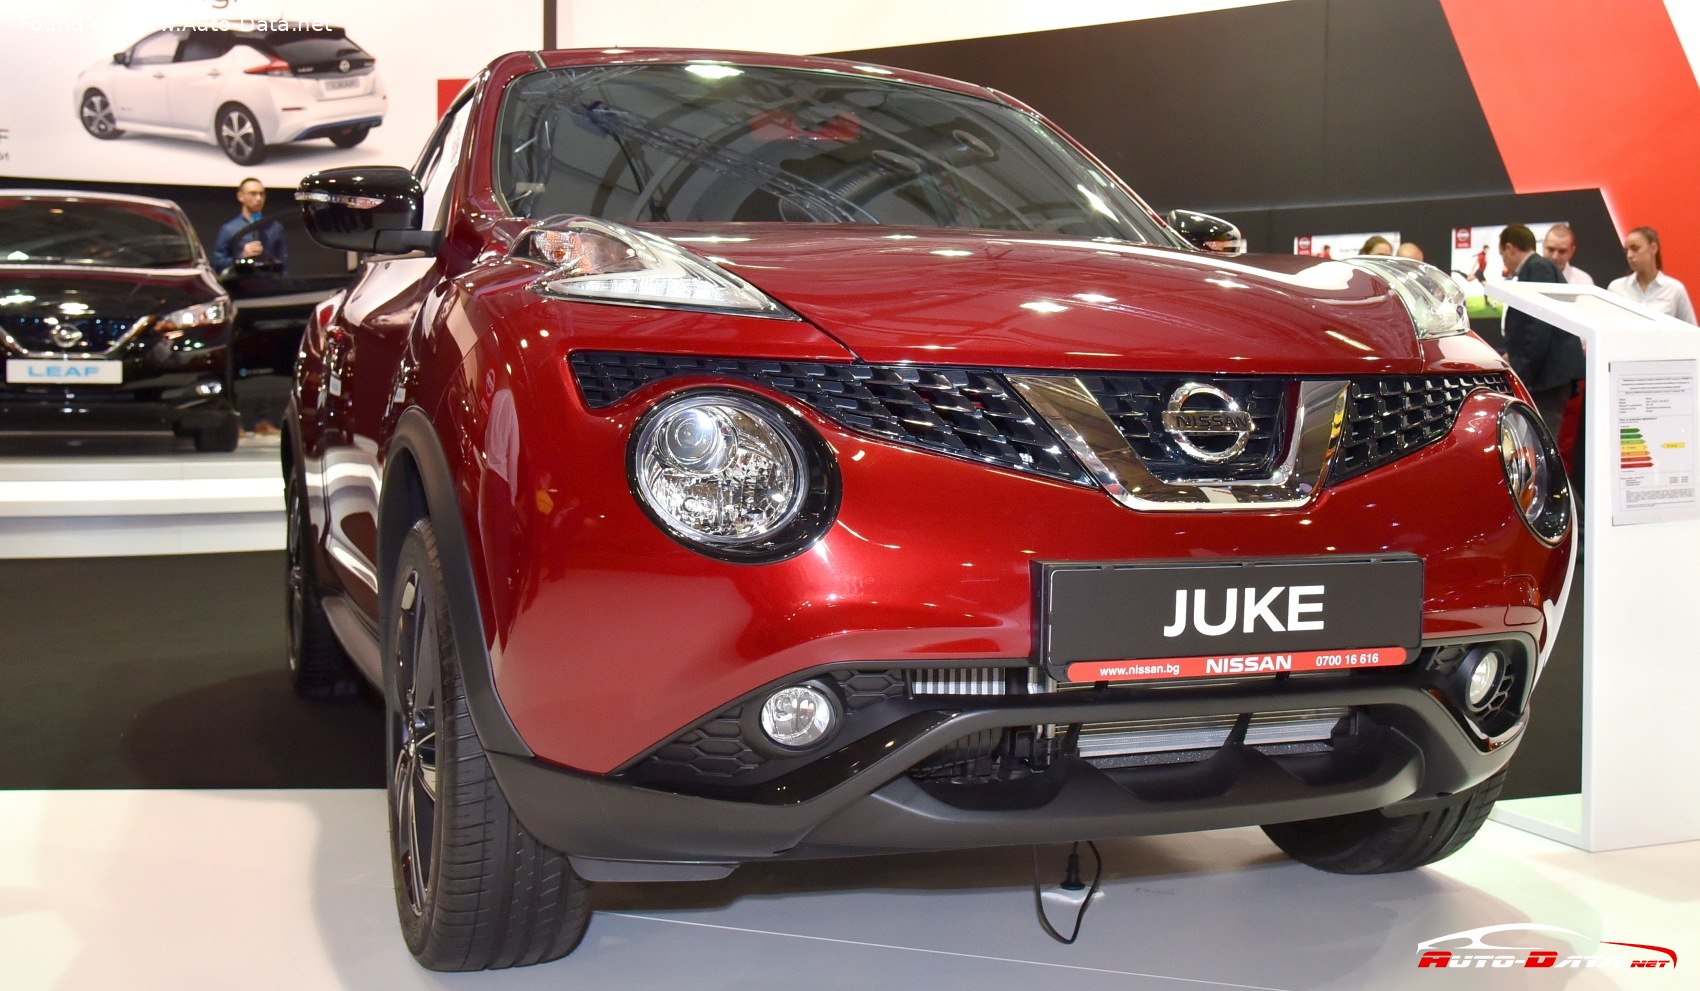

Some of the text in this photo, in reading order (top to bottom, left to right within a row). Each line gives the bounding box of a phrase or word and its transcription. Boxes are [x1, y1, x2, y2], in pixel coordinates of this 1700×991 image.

[28, 365, 99, 378] LEAF
[1179, 413, 1248, 428] NISSAN
[1163, 585, 1325, 637] JUKE
[1099, 653, 1379, 678] www.nissan.bg NISSAN 0700 16 616
